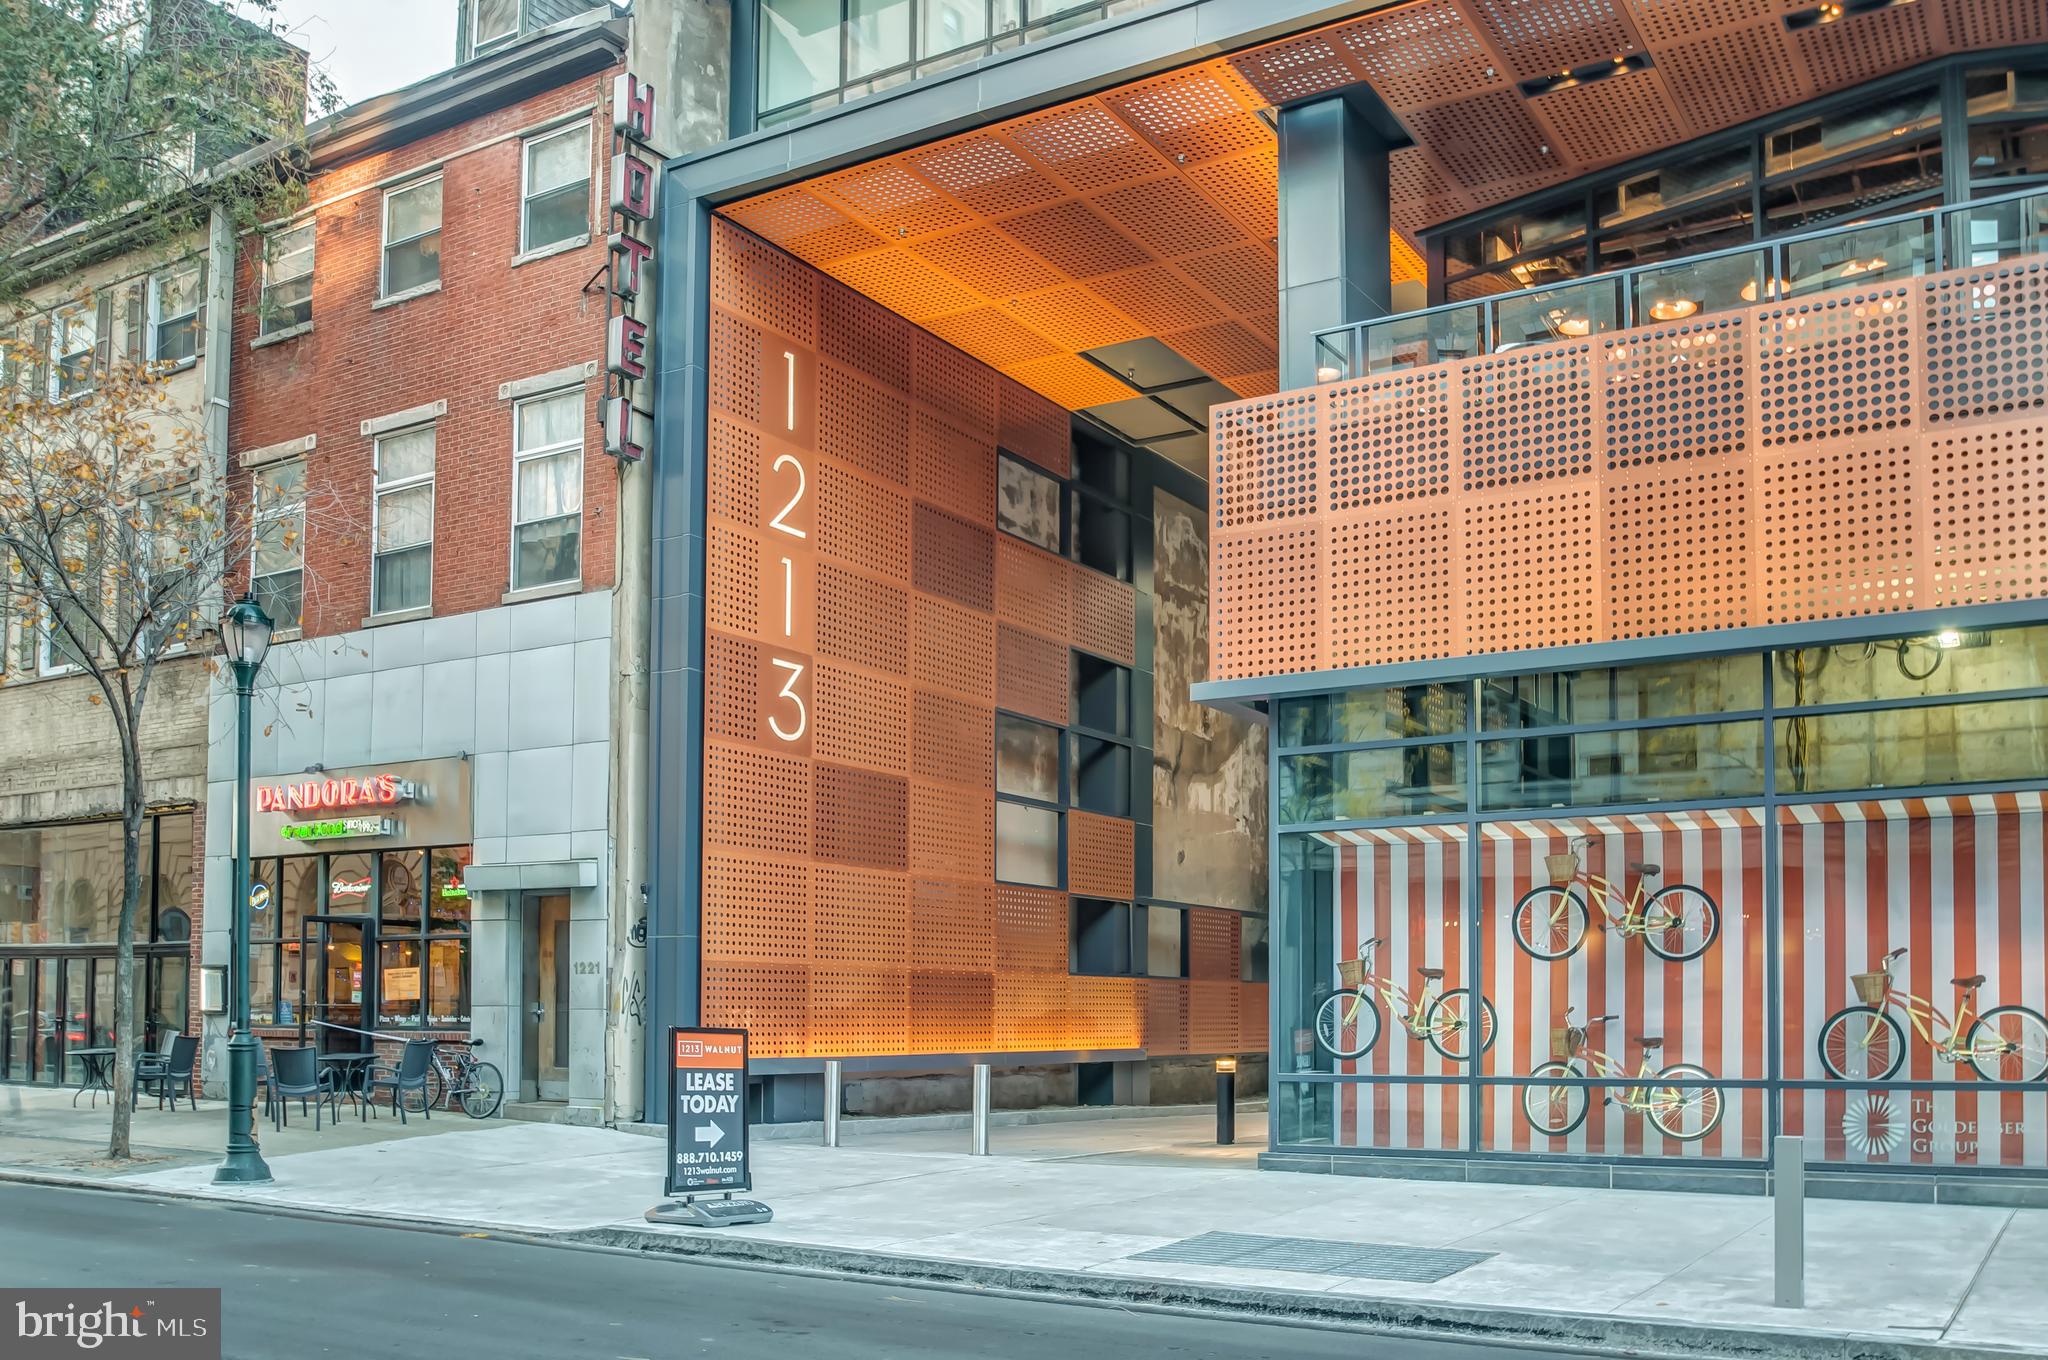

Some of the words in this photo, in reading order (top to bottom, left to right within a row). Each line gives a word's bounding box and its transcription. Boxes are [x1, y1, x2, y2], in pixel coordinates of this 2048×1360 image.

[607, 72, 656, 463] HOTEL
[768, 351, 807, 741] 1213
[256, 773, 396, 812] PANDORA'S
[573, 961, 600, 975] 1221
[681, 1044, 700, 1054] 1213
[704, 1045, 742, 1055] WALNUT
[686, 1072, 734, 1091] LEASE
[680, 1094, 739, 1114] TODAY
[676, 1150, 743, 1164] 888.710.1459
[683, 1165, 737, 1176] 1213walnut.com
